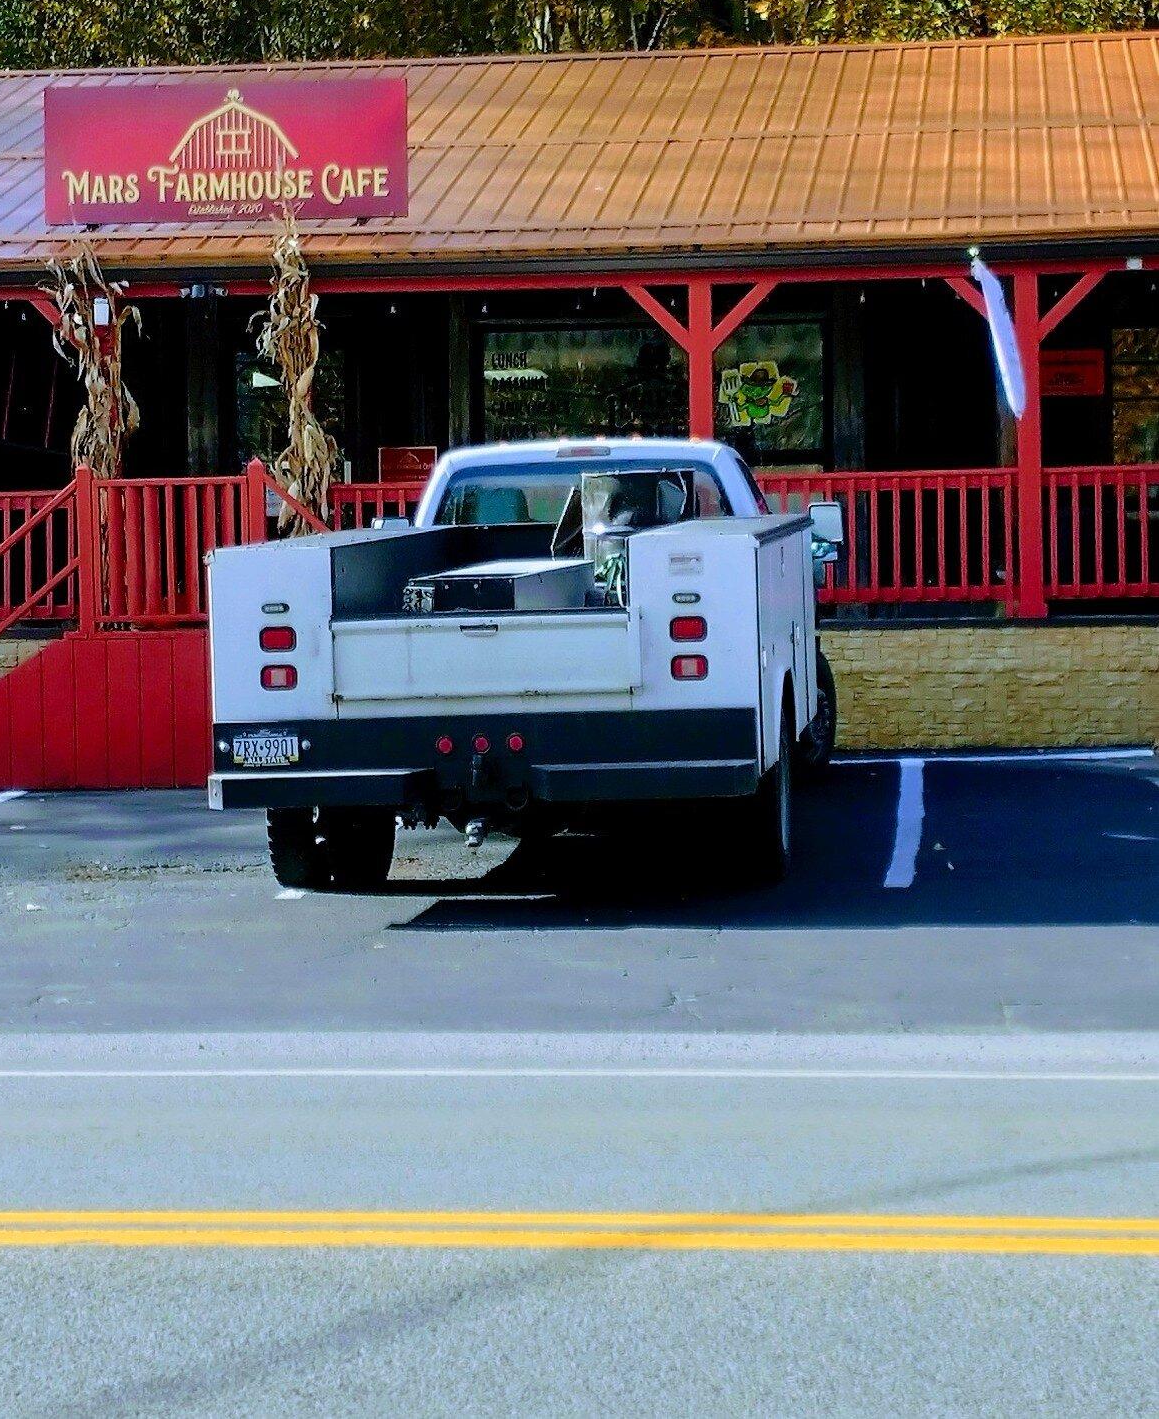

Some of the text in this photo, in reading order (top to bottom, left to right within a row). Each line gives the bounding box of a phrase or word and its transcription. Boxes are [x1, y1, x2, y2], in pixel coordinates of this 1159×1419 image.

[61, 163, 390, 205] MARS FARMHOUSE CAFE
